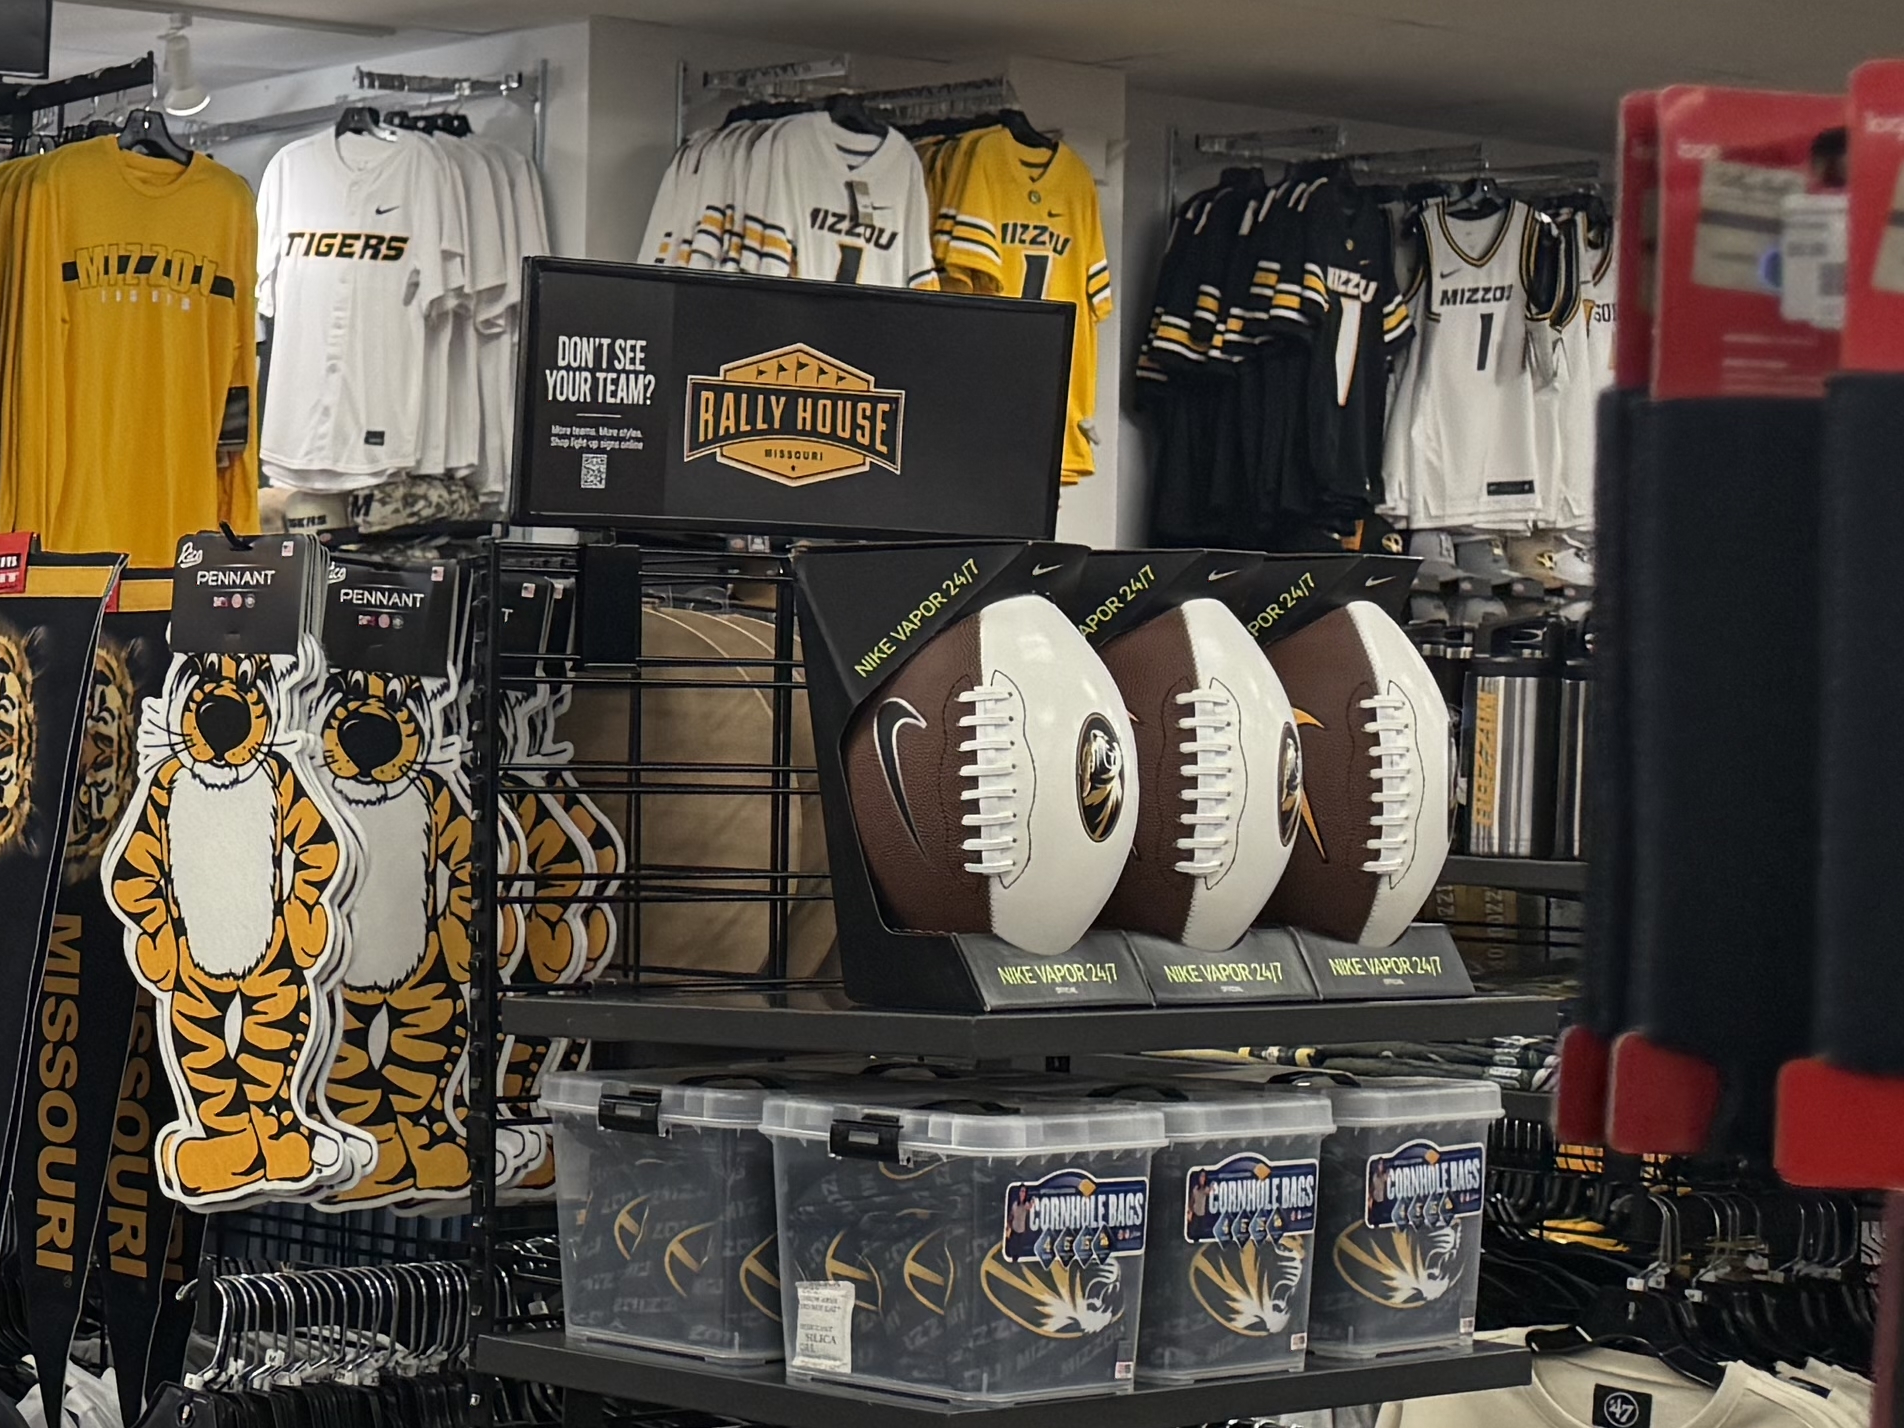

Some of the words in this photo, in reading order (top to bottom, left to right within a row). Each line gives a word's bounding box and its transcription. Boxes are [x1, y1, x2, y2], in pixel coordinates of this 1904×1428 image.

[283, 230, 410, 262] TIGERS
[557, 335, 611, 369] DON'T
[613, 338, 647, 371] SEE
[1477, 313, 1493, 371] 1
[545, 369, 592, 402] YOUR
[596, 372, 656, 405] TEAM?
[698, 390, 786, 443] RALLY
[796, 397, 890, 454] HOUSE
[550, 437, 569, 448] Shop
[764, 448, 824, 461] MISSOURI
[196, 570, 276, 587] PENNANT
[327, 561, 346, 584] ico
[339, 589, 425, 609] PENNANT
[1079, 594, 1124, 641] APOR
[1116, 564, 1157, 609] 24/7
[1280, 572, 1317, 613] 24/7
[854, 638, 896, 678] NIKE
[889, 590, 948, 644] VAPOR
[941, 558, 982, 598] 24/7
[997, 965, 1033, 985] NIKE
[1034, 964, 1085, 984] VAPOR
[1086, 963, 1118, 982] 24/7
[1163, 965, 1199, 983] NIKE
[1200, 964, 1250, 982] VAPOR
[1251, 962, 1283, 982] 24/7
[1328, 958, 1362, 976] NIKE
[1363, 957, 1413, 975] VAPOR
[1414, 956, 1442, 975] 24/7
[35, 913, 82, 1270] MISSOURI
[1208, 1178, 1280, 1215] CORNHOLE
[1282, 1174, 1314, 1208] BAGS
[1386, 1162, 1451, 1200] CORNHOLE
[1451, 1158, 1481, 1191] BAGS
[1030, 1194, 1106, 1232] CORNHOLE
[1109, 1192, 1144, 1227] BAGS
[805, 1333, 837, 1345] SILICA
